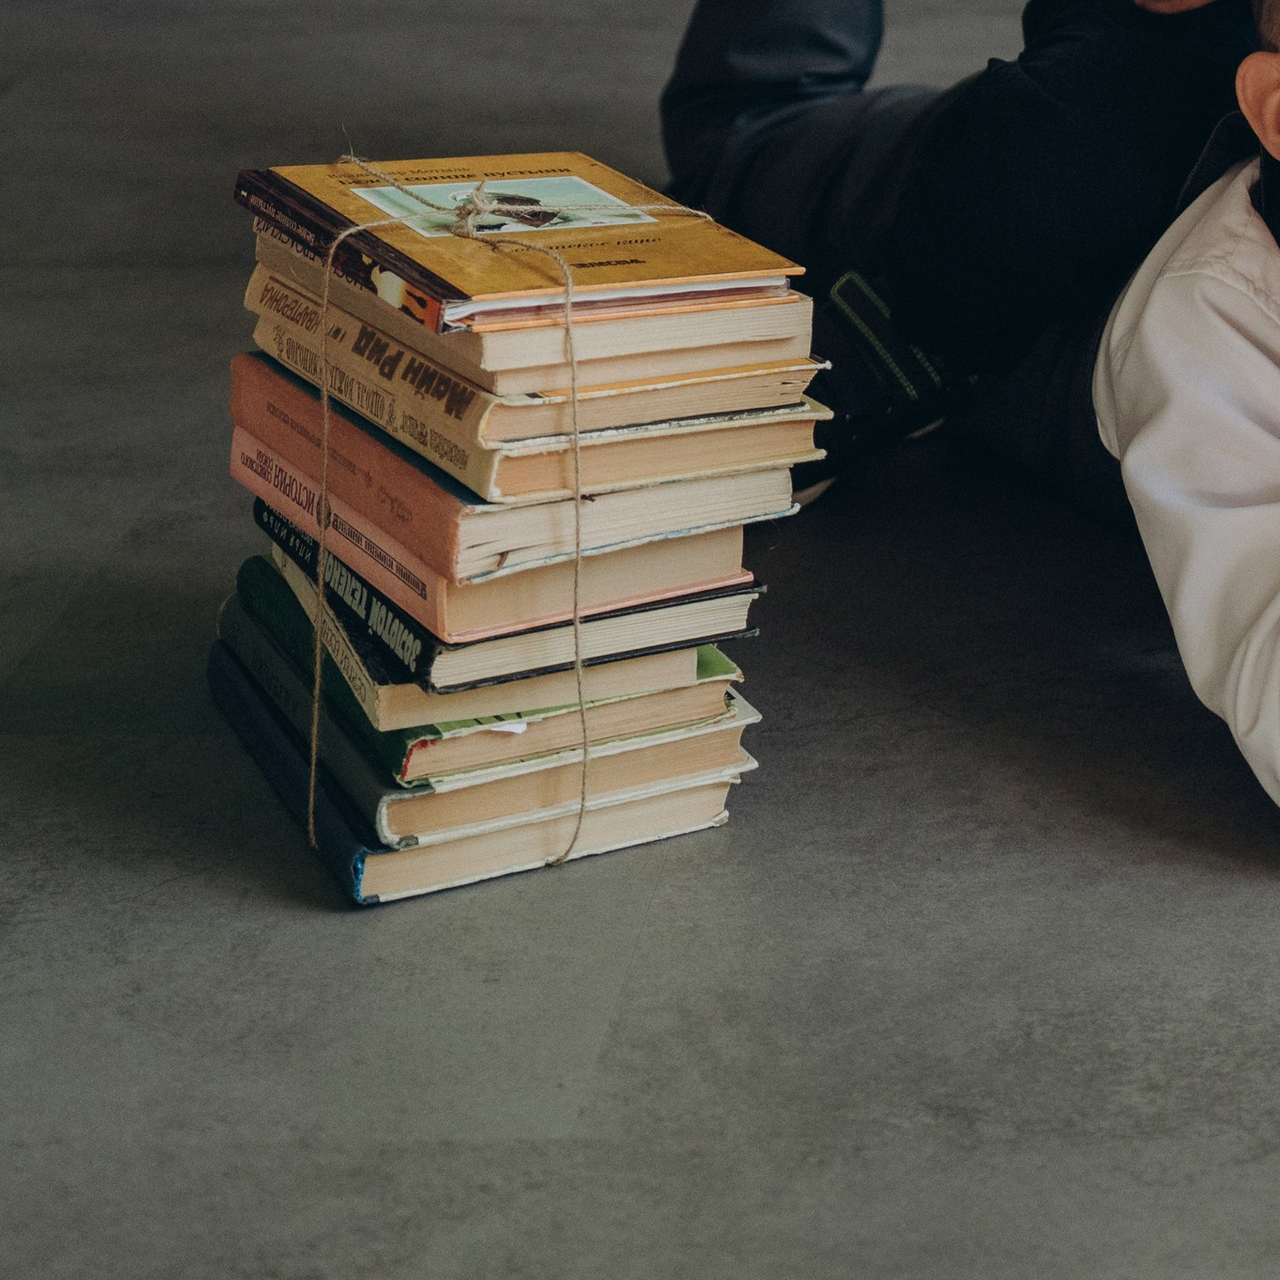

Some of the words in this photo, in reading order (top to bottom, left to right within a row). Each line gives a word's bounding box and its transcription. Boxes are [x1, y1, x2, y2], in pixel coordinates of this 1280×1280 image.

[351, 325, 405, 382] Рид
[399, 358, 475, 421] Майн
[271, 464, 316, 515] ИСТОРИЯ
[360, 594, 423, 673] ЗОЛОТОЙ
